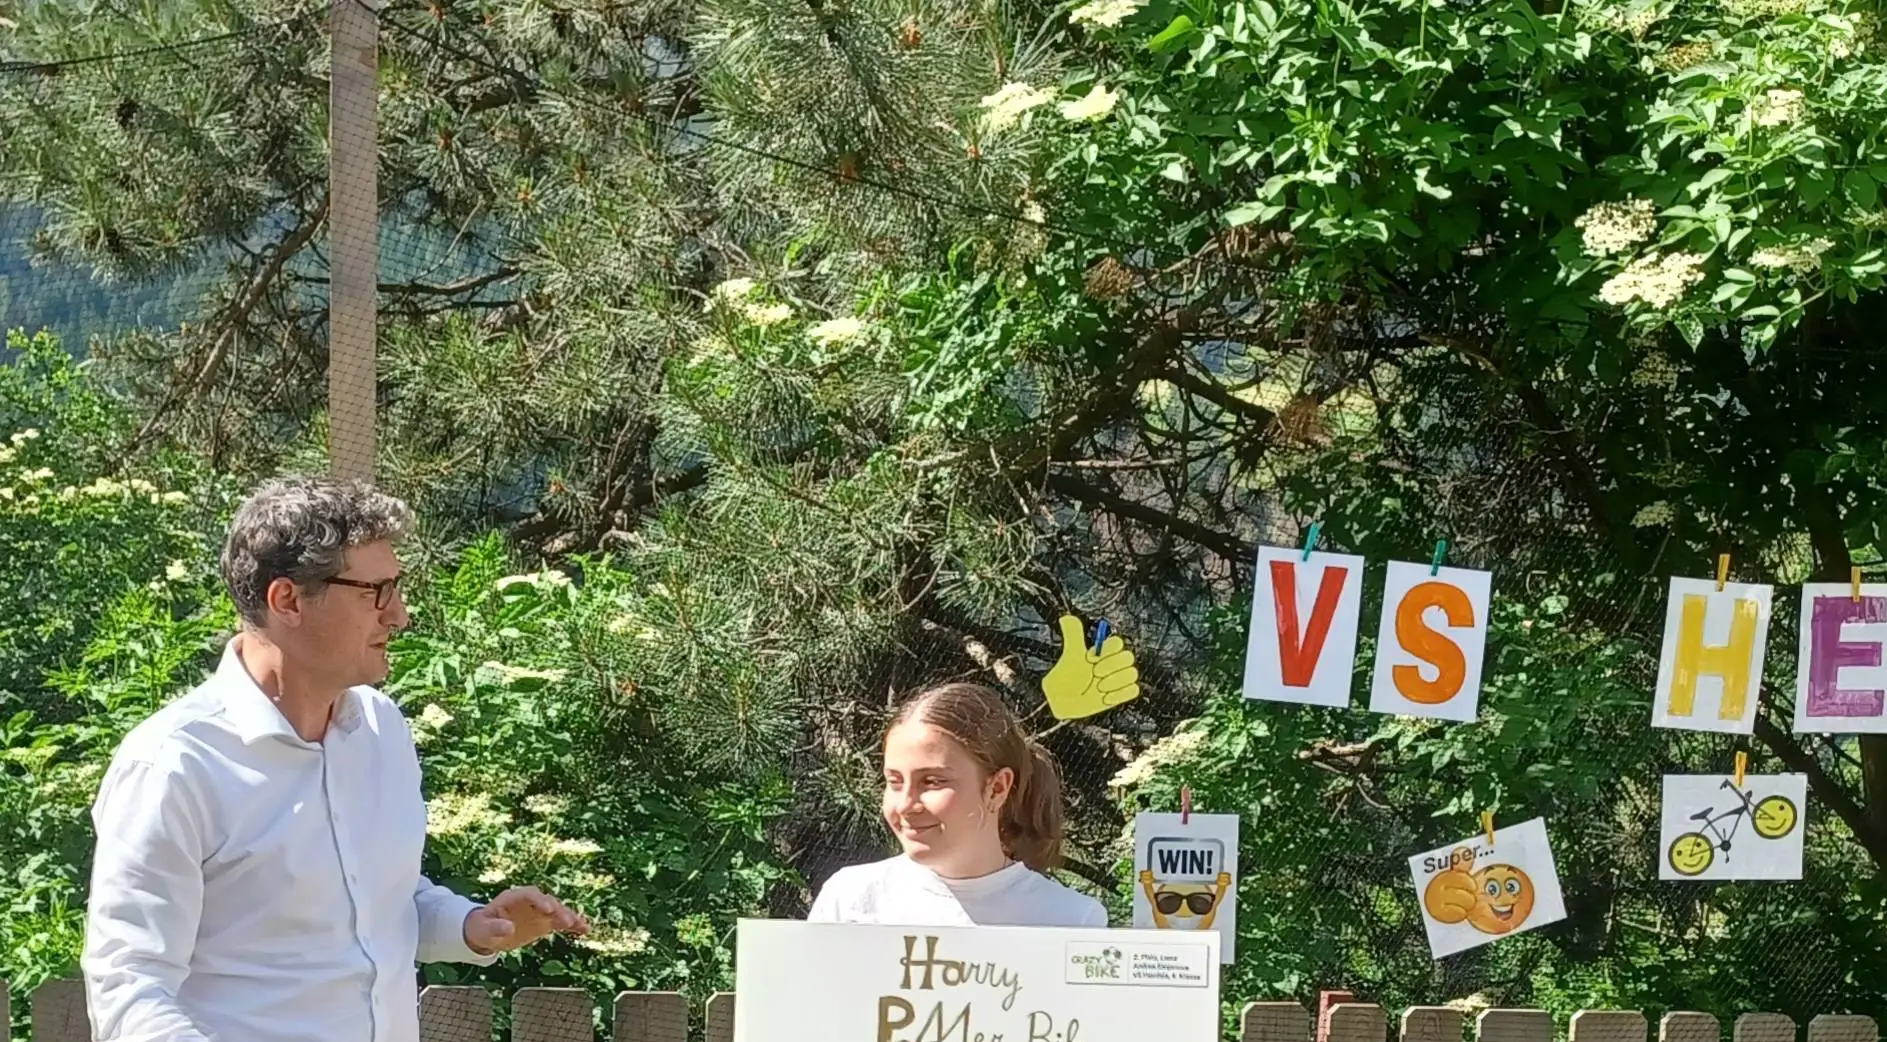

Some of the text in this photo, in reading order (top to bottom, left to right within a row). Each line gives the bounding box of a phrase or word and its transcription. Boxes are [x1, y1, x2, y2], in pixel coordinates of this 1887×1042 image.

[1269, 560, 1887, 721] VS HE
[1158, 849, 1213, 874] WIN!
[1424, 844, 1494, 874] Super...
[900, 936, 1022, 1011] Harry
[1071, 955, 1101, 965] CRAZY
[1085, 964, 1121, 979] BIKE
